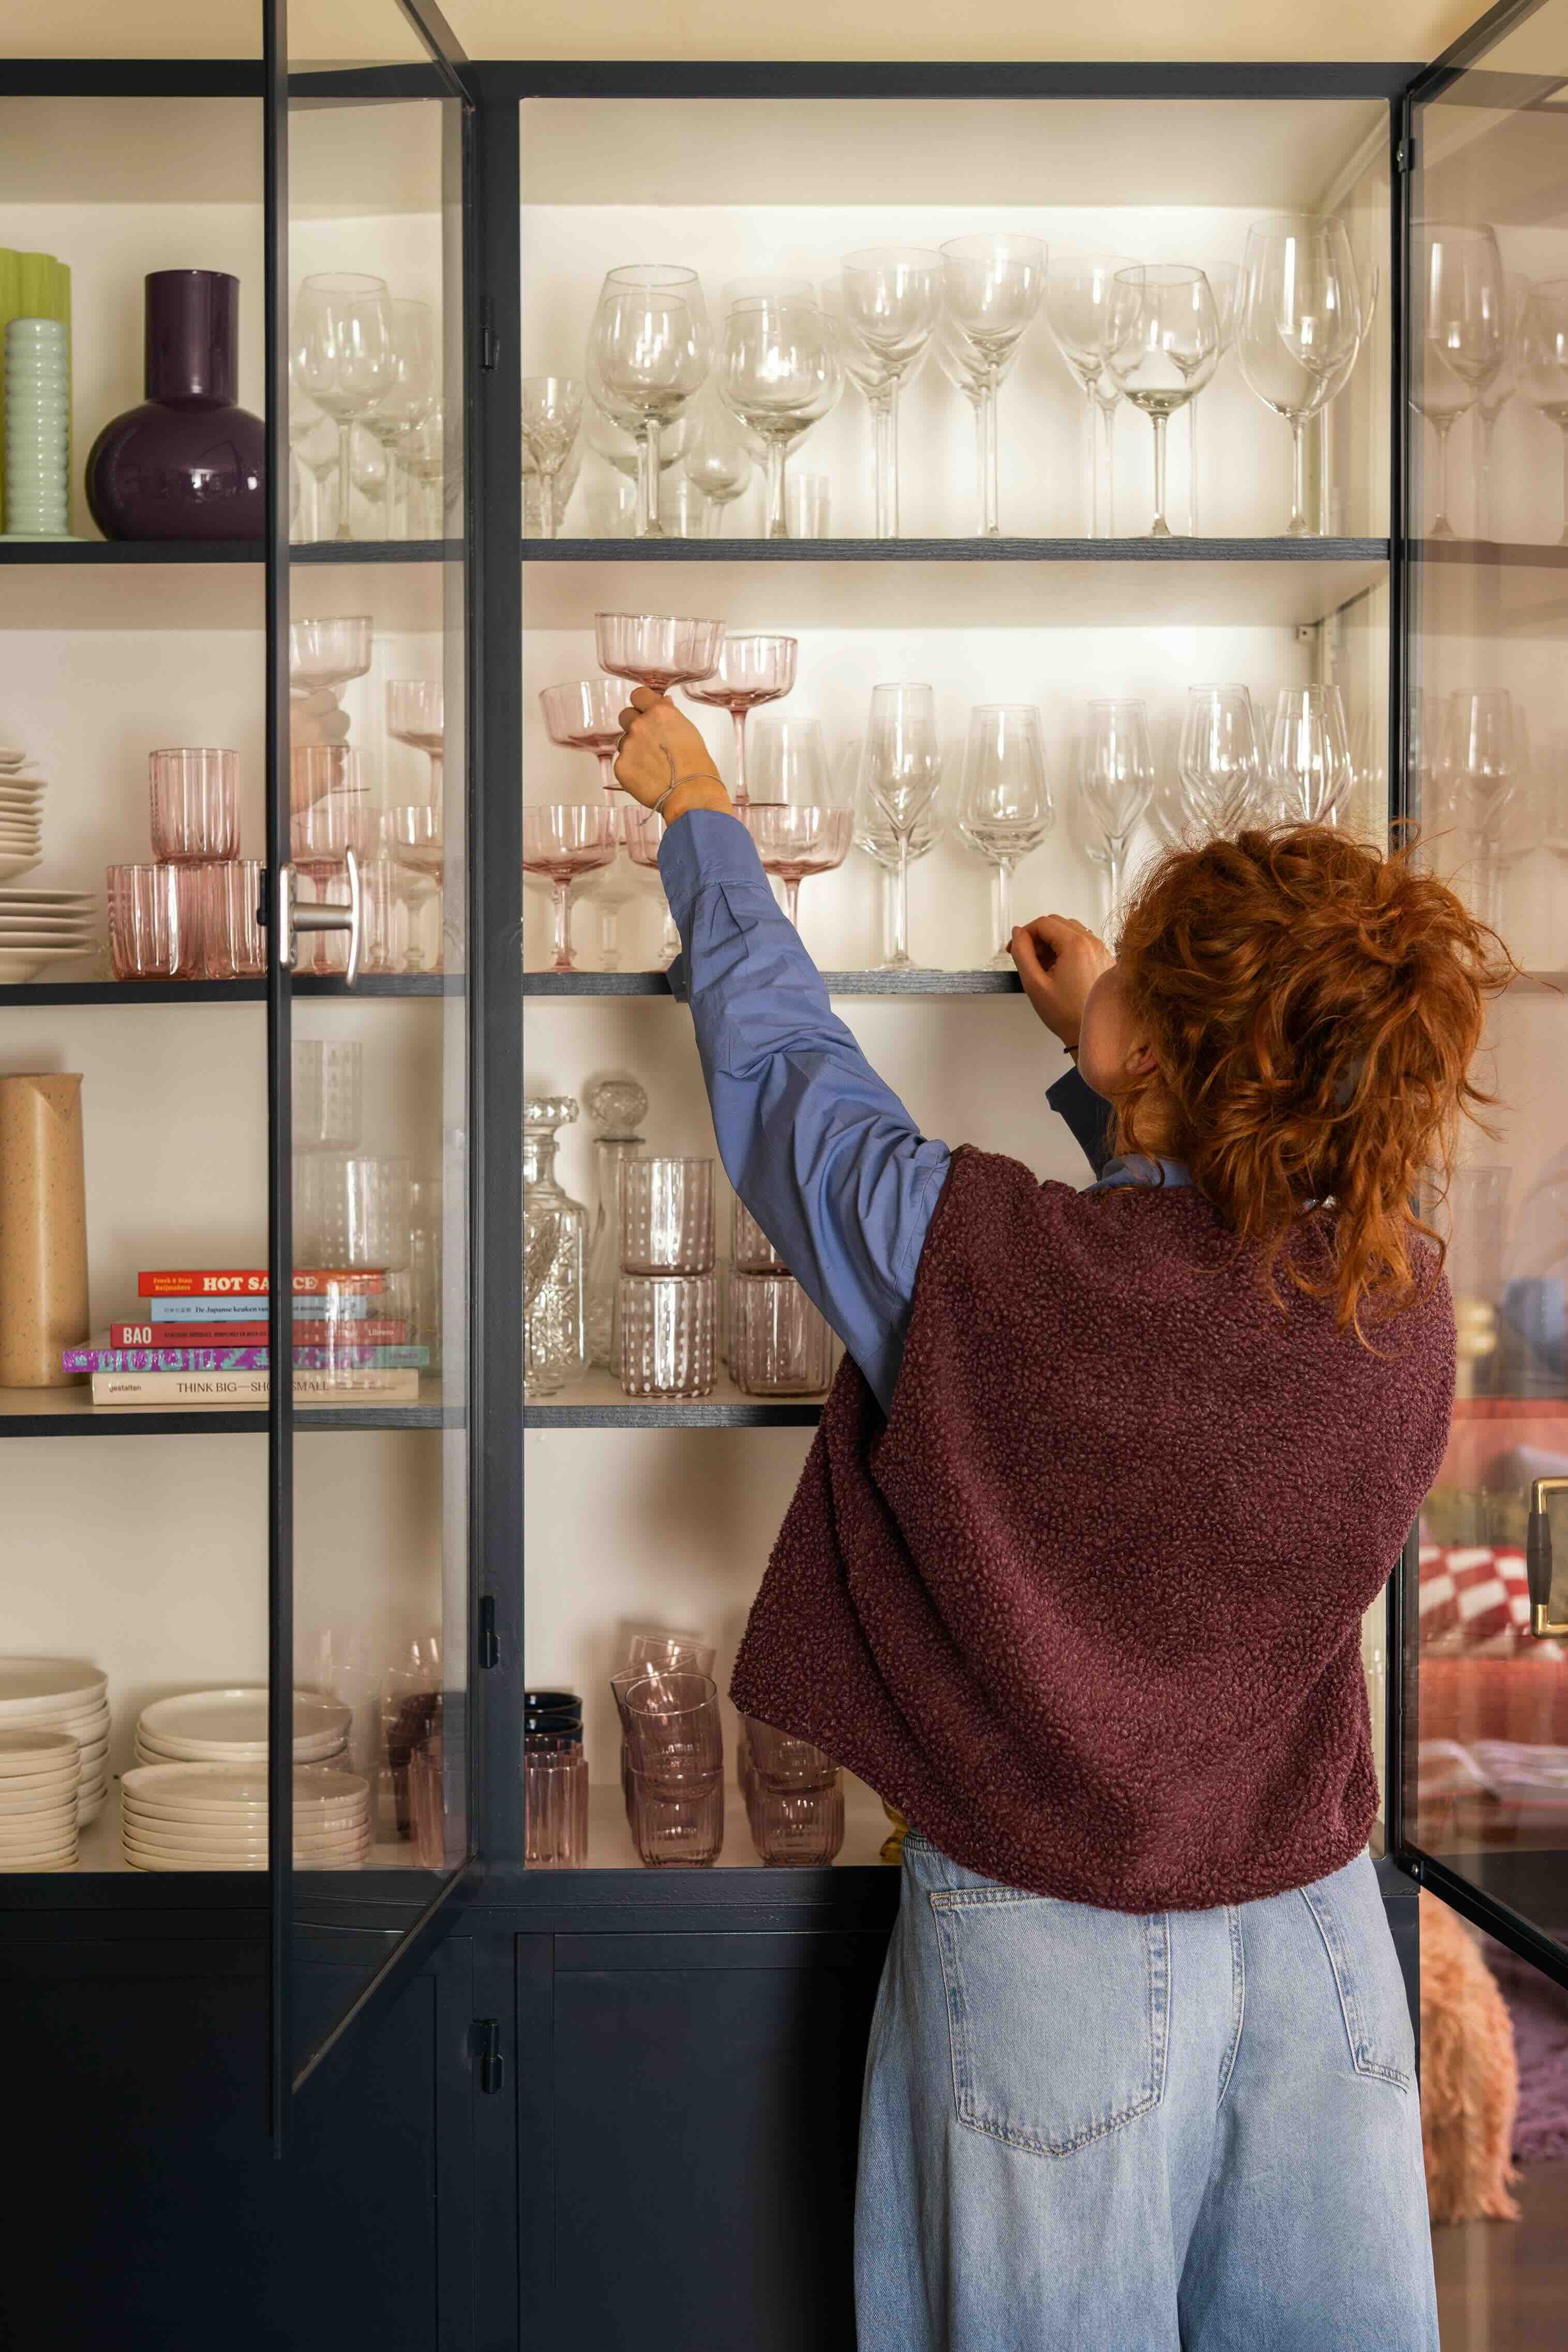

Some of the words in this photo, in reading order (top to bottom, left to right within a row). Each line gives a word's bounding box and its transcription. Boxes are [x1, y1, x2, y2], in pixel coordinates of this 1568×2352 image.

[203, 1277, 244, 1291] HOT
[248, 1275, 318, 1291] SACE
[123, 1327, 152, 1344] BAO
[109, 1384, 142, 1393] gestalten
[176, 1382, 213, 1393] THINK
[292, 1380, 329, 1391] SMALL
